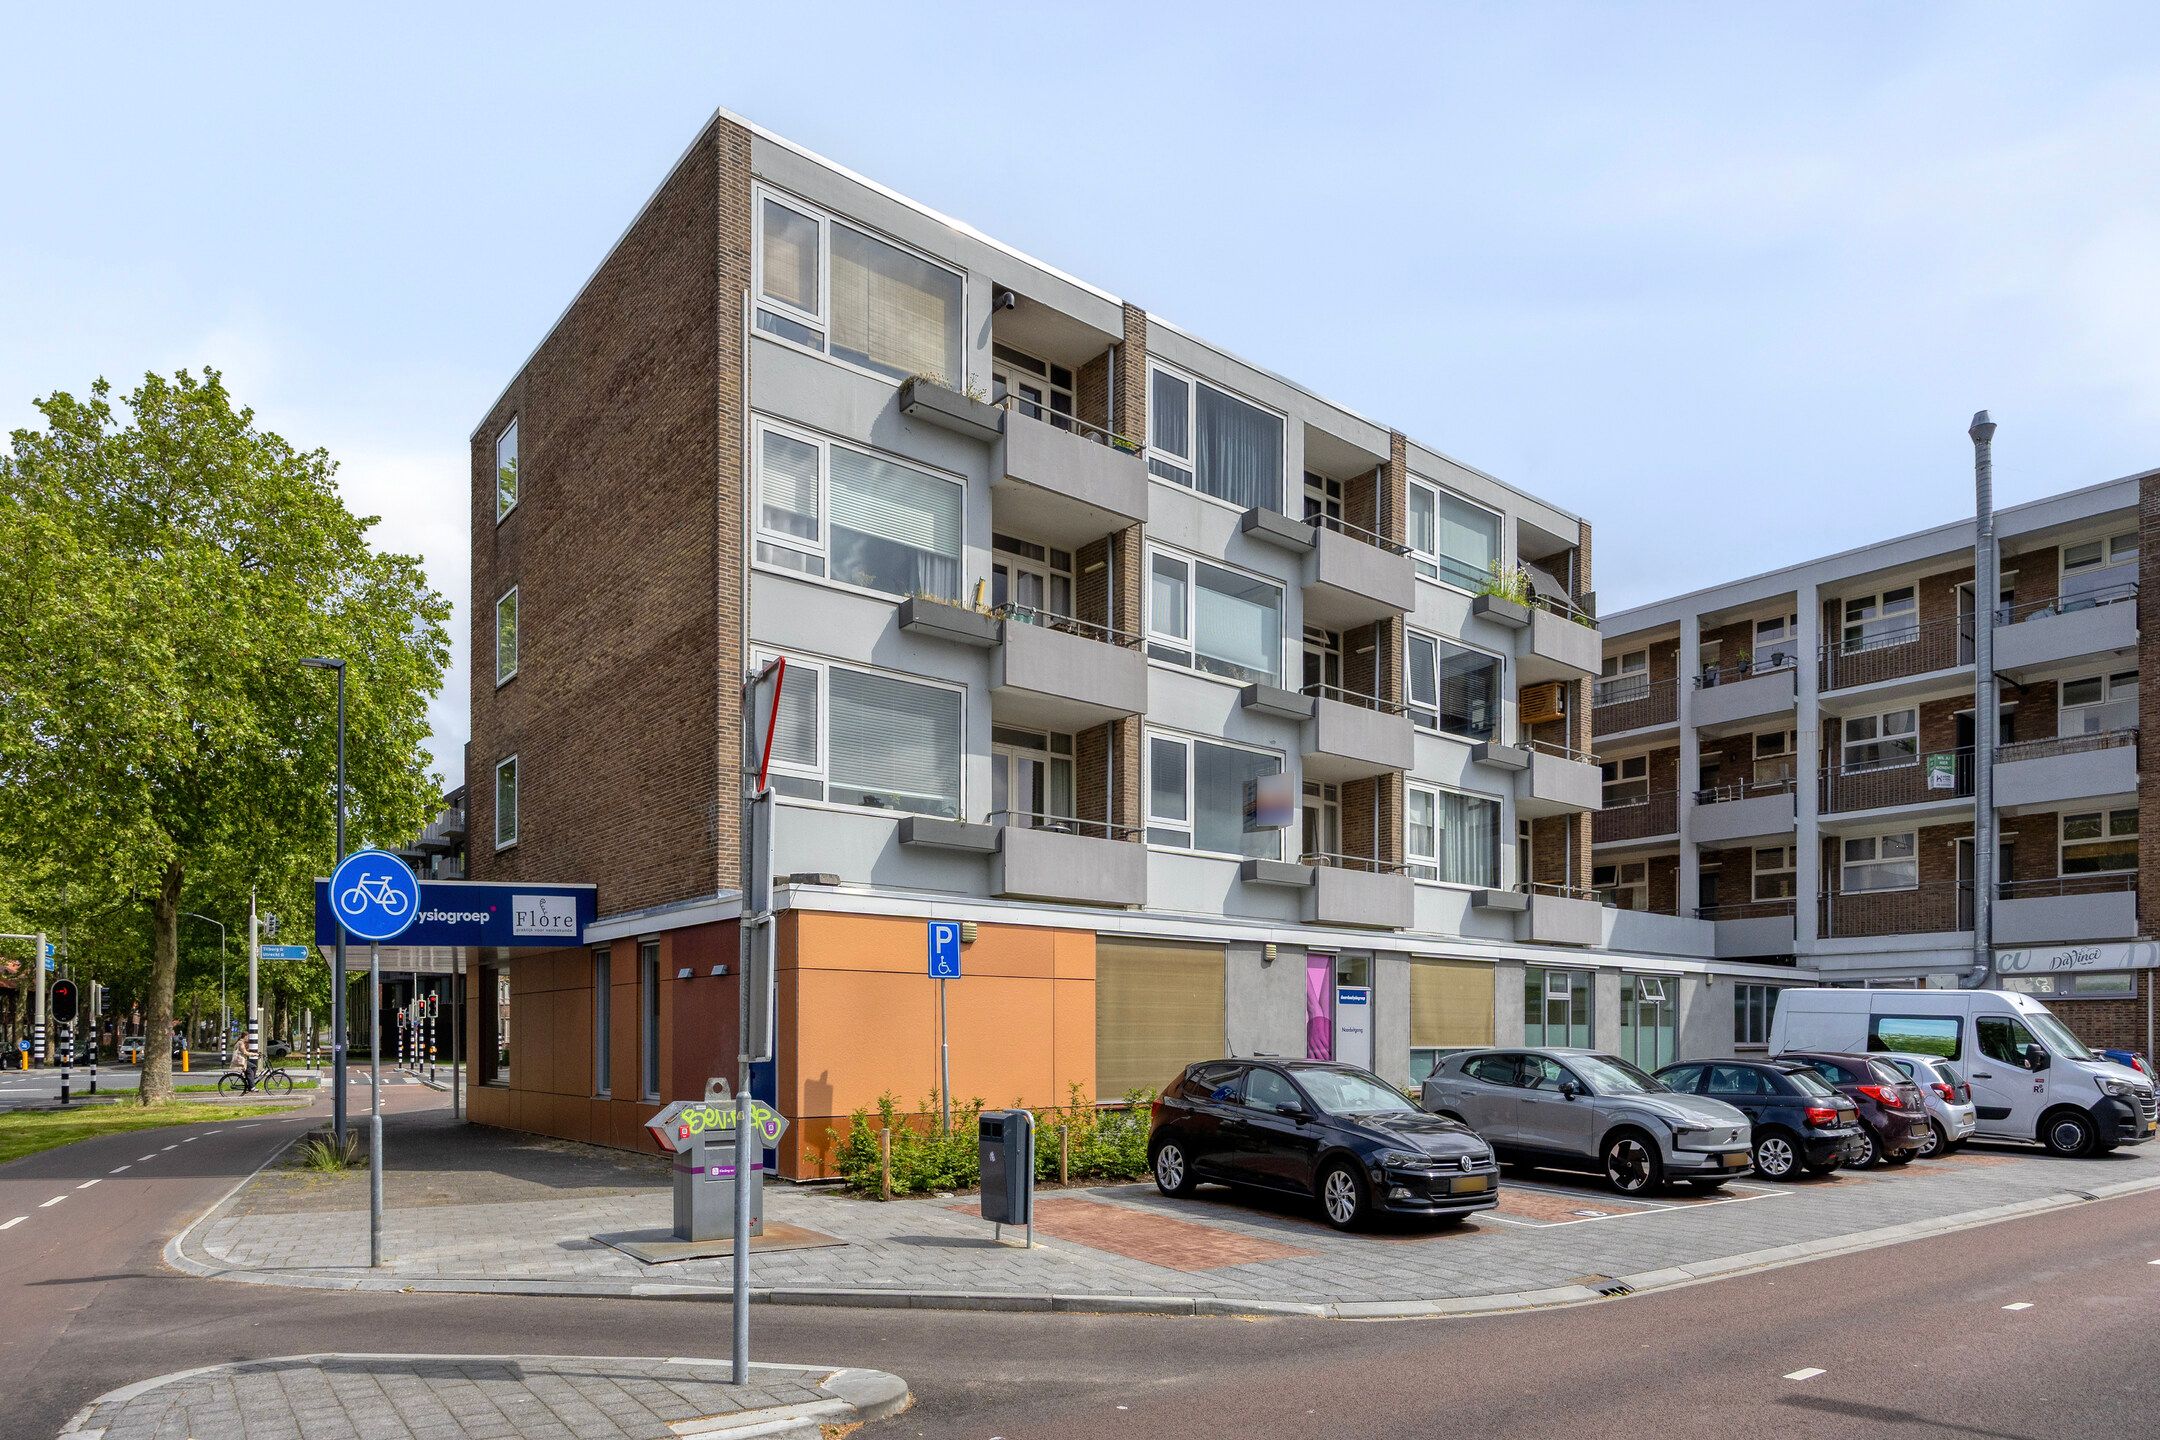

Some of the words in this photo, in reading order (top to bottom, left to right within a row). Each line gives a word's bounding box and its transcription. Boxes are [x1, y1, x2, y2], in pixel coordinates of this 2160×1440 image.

[415, 909, 490, 924] ysiogroep
[515, 910, 574, 927] Flore
[936, 926, 953, 954] P
